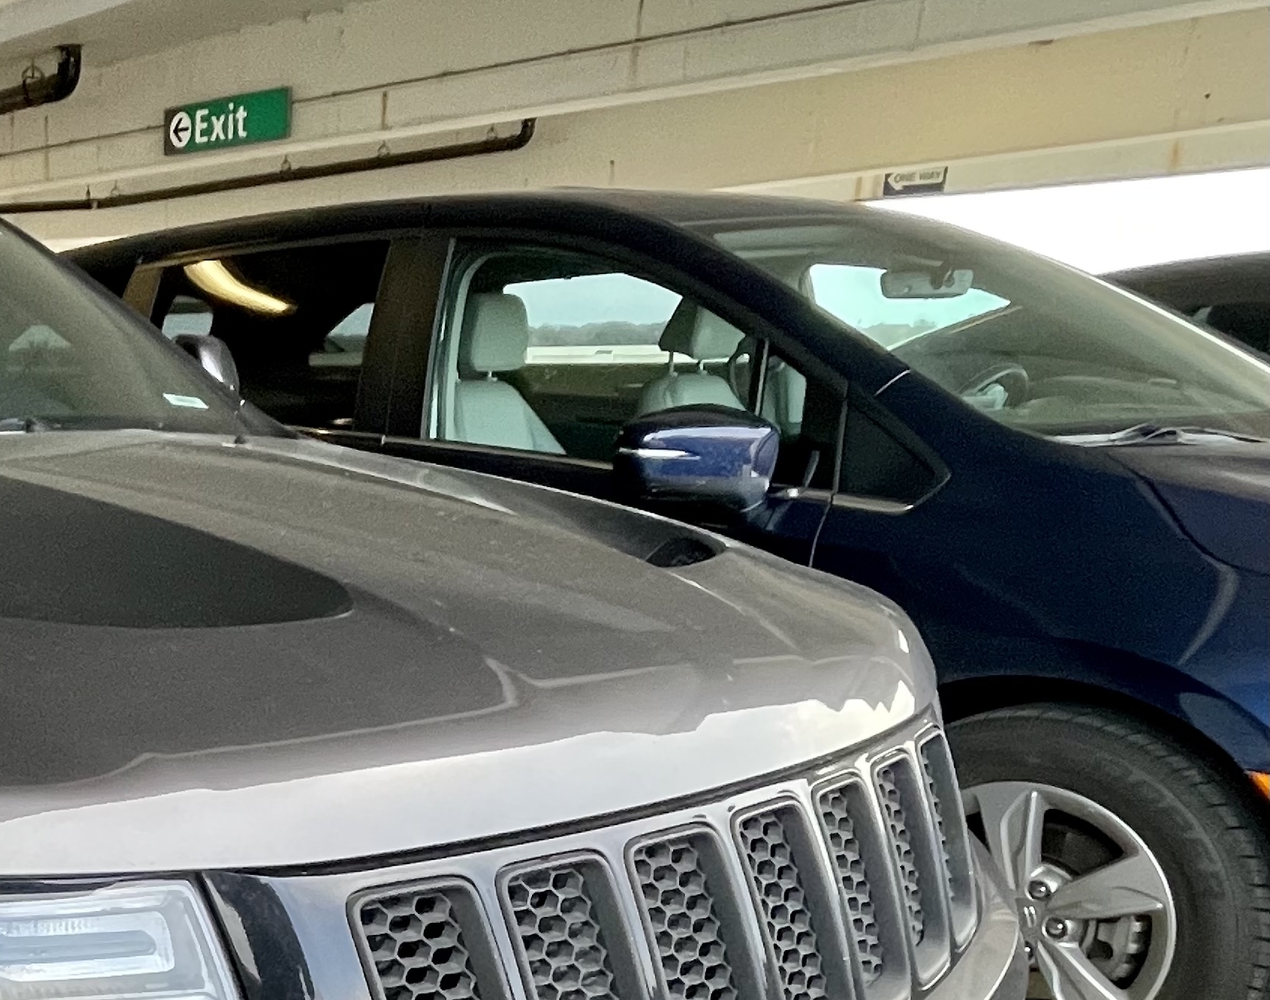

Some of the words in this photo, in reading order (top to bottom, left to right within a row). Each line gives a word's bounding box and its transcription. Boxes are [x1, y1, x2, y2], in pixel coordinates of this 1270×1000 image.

[195, 102, 247, 143] Exit
[894, 172, 916, 183] ONE
[920, 170, 942, 180] WAY
